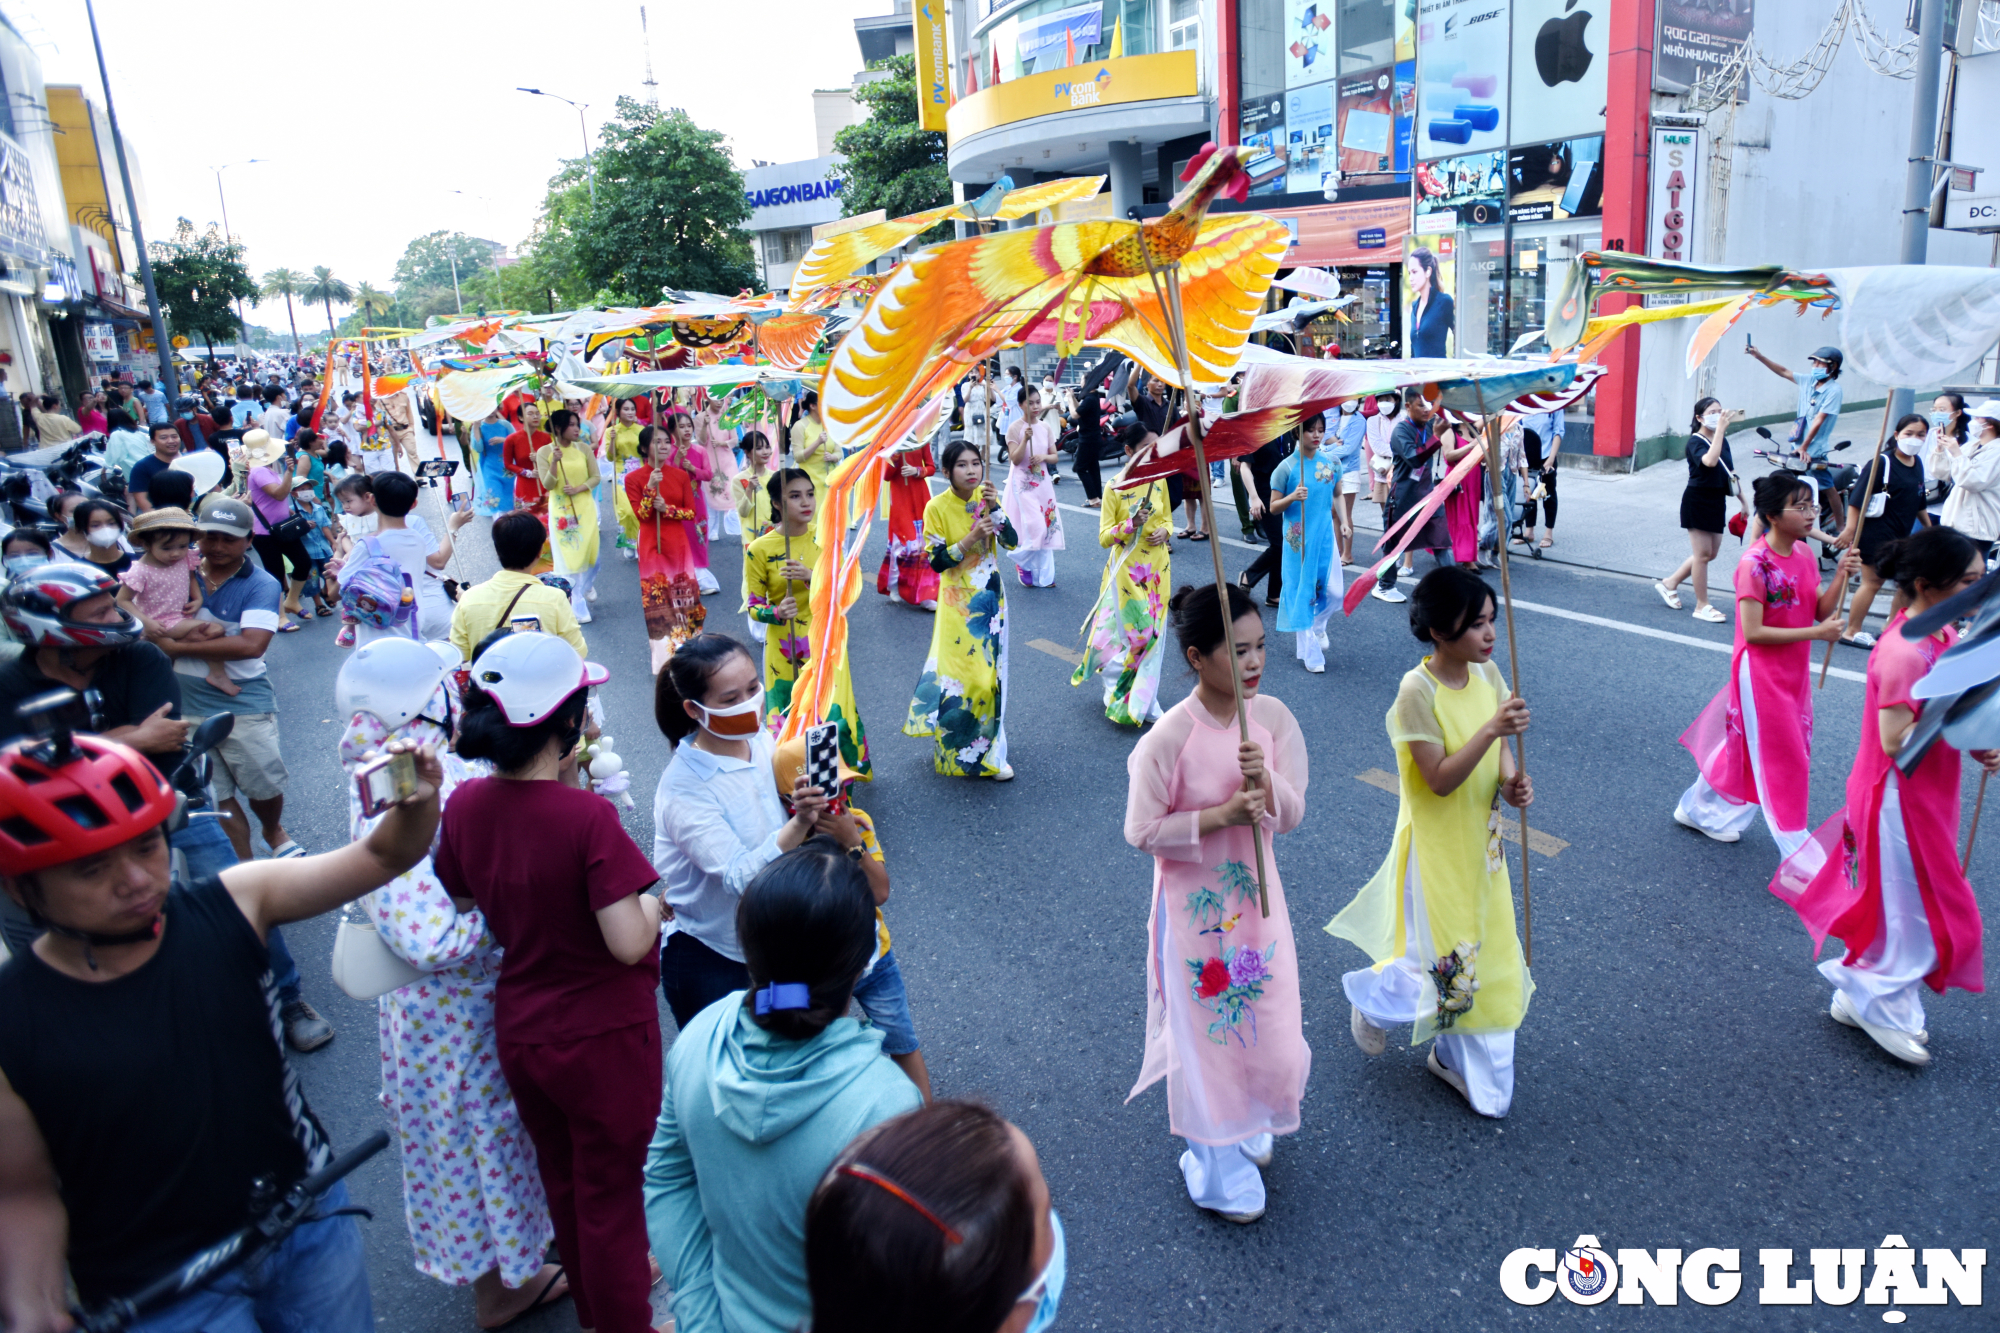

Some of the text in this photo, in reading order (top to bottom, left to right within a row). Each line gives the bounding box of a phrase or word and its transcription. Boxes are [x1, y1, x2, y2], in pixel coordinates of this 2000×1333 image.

[1466, 9, 1503, 26] BOSE
[1664, 25, 1710, 45] ROG G20
[1663, 43, 1684, 58] NHỎ
[1686, 48, 1718, 64] NHƯNG
[1664, 135, 1692, 144] HUE
[1970, 206, 1996, 218] ĐC:
[1469, 261, 1496, 271] AKG
[87, 338, 97, 350] XE
